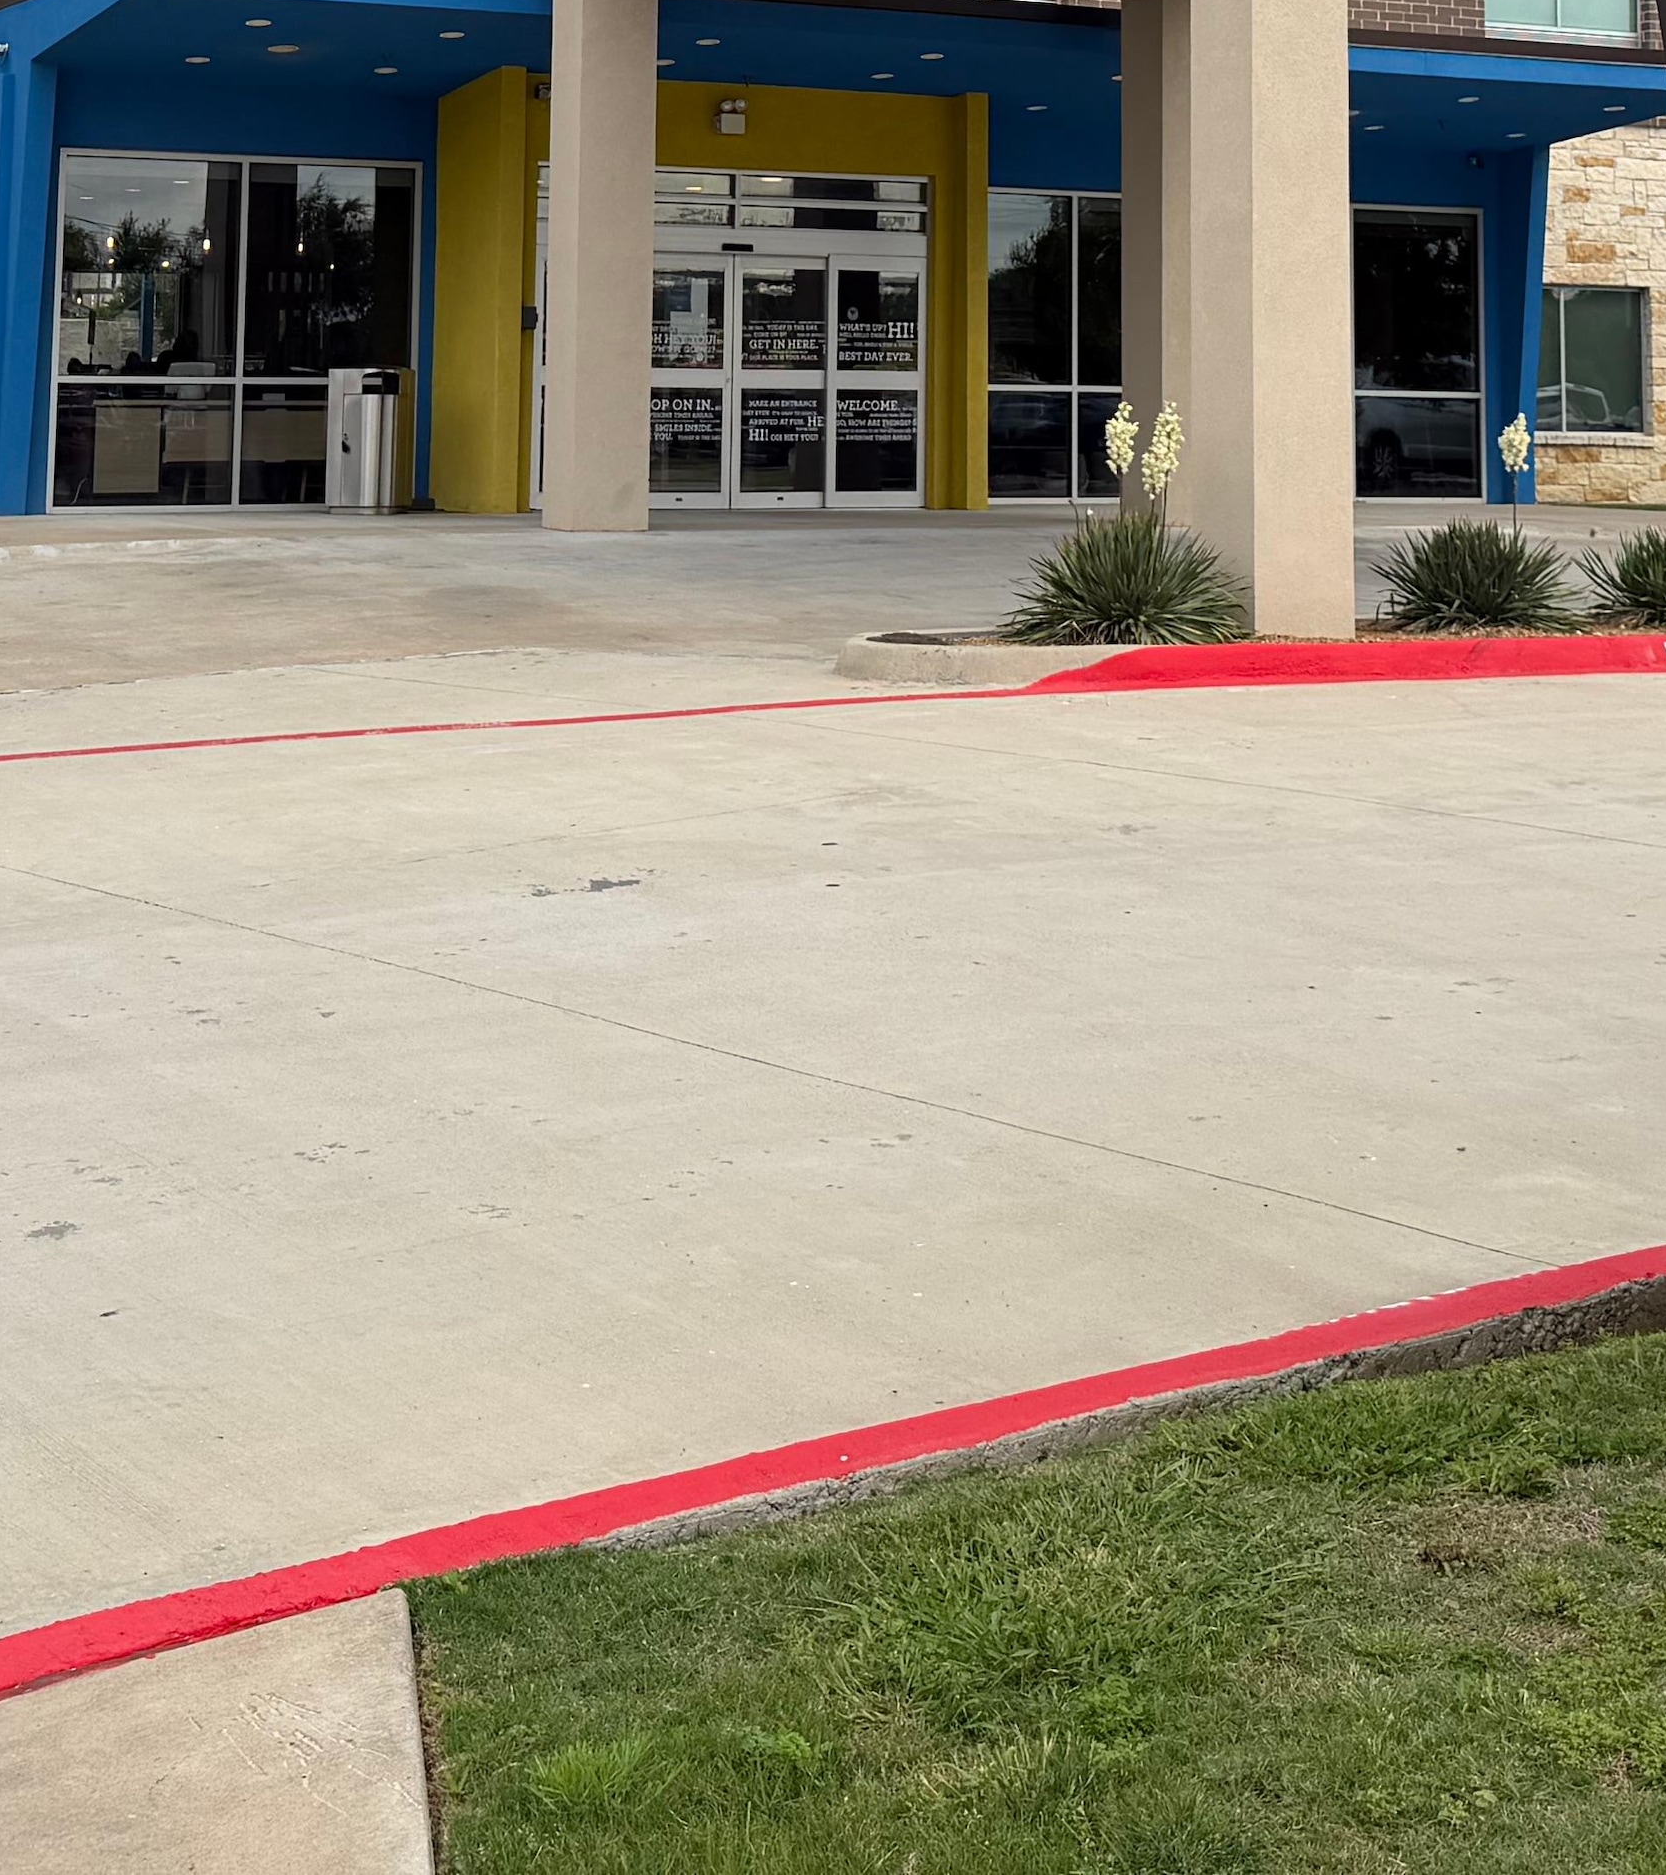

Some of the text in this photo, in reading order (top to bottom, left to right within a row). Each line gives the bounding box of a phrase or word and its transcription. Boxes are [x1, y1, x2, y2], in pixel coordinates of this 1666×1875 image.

[887, 321, 915, 339] HI!
[749, 339, 820, 350] GET IN HERE.
[838, 351, 863, 361] BEST
[864, 351, 885, 362] DAY
[651, 399, 670, 411] OP
[672, 399, 693, 411] ON
[748, 428, 769, 442] HI!
